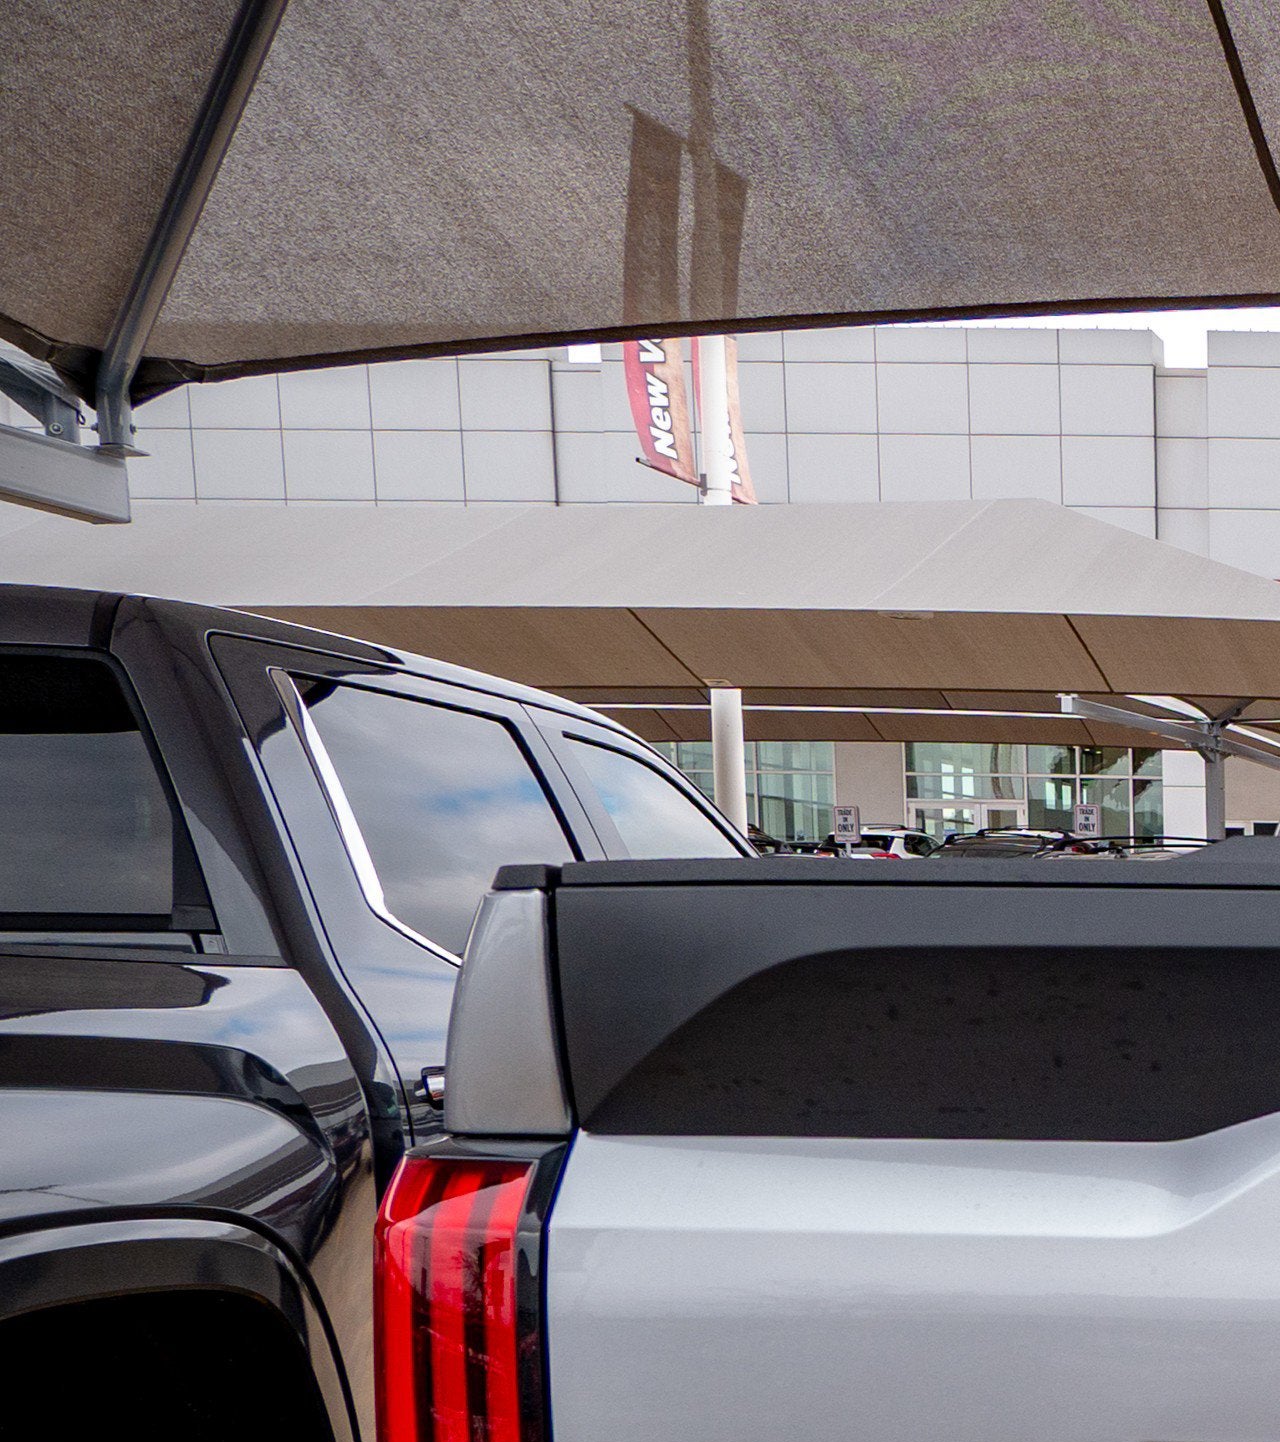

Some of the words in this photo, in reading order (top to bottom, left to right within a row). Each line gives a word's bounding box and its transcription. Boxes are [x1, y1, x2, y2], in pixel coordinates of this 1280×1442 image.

[645, 372, 679, 461] New
[838, 823, 854, 832] ONLY
[1079, 823, 1095, 832] ONLY
